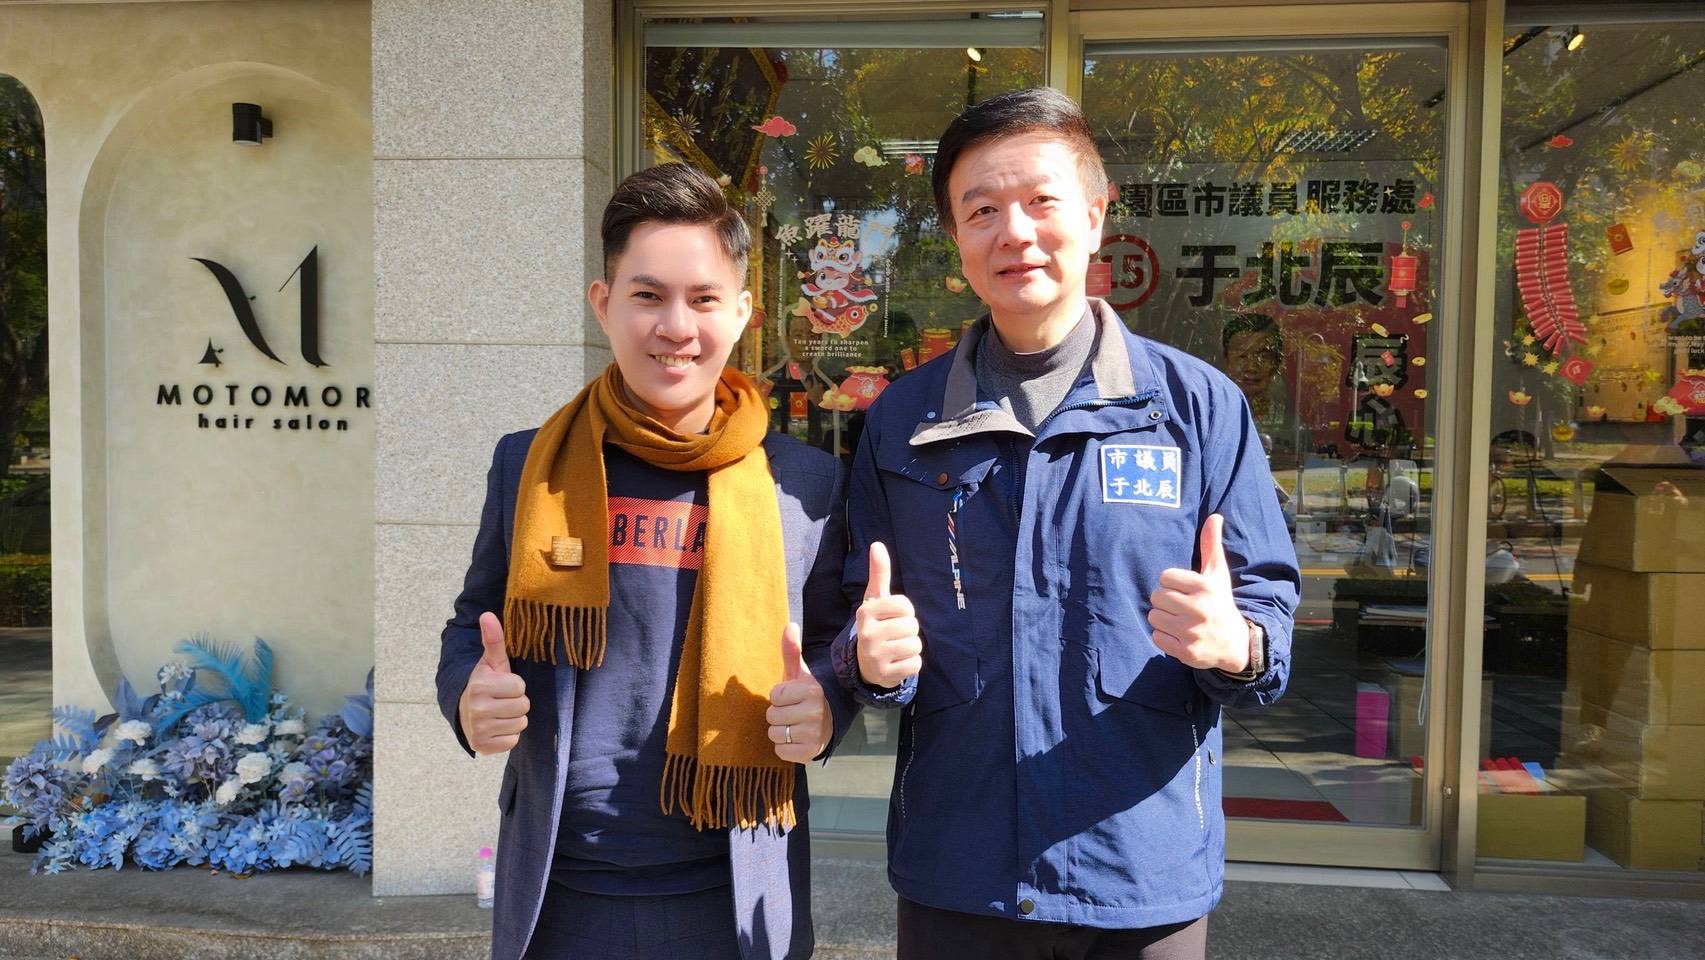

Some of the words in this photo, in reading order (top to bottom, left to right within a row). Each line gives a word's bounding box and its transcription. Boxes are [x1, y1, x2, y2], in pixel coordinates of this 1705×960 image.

[1107, 179, 1416, 217] 園區市議員服務處
[775, 213, 897, 248] 魚躍龍
[1176, 241, 1384, 307] 于北辰
[156, 384, 371, 408] MOTOMOR
[198, 413, 254, 429] hair
[273, 414, 348, 431] salon
[1107, 449, 1177, 473] 市議員
[1109, 477, 1176, 499] 于北辰
